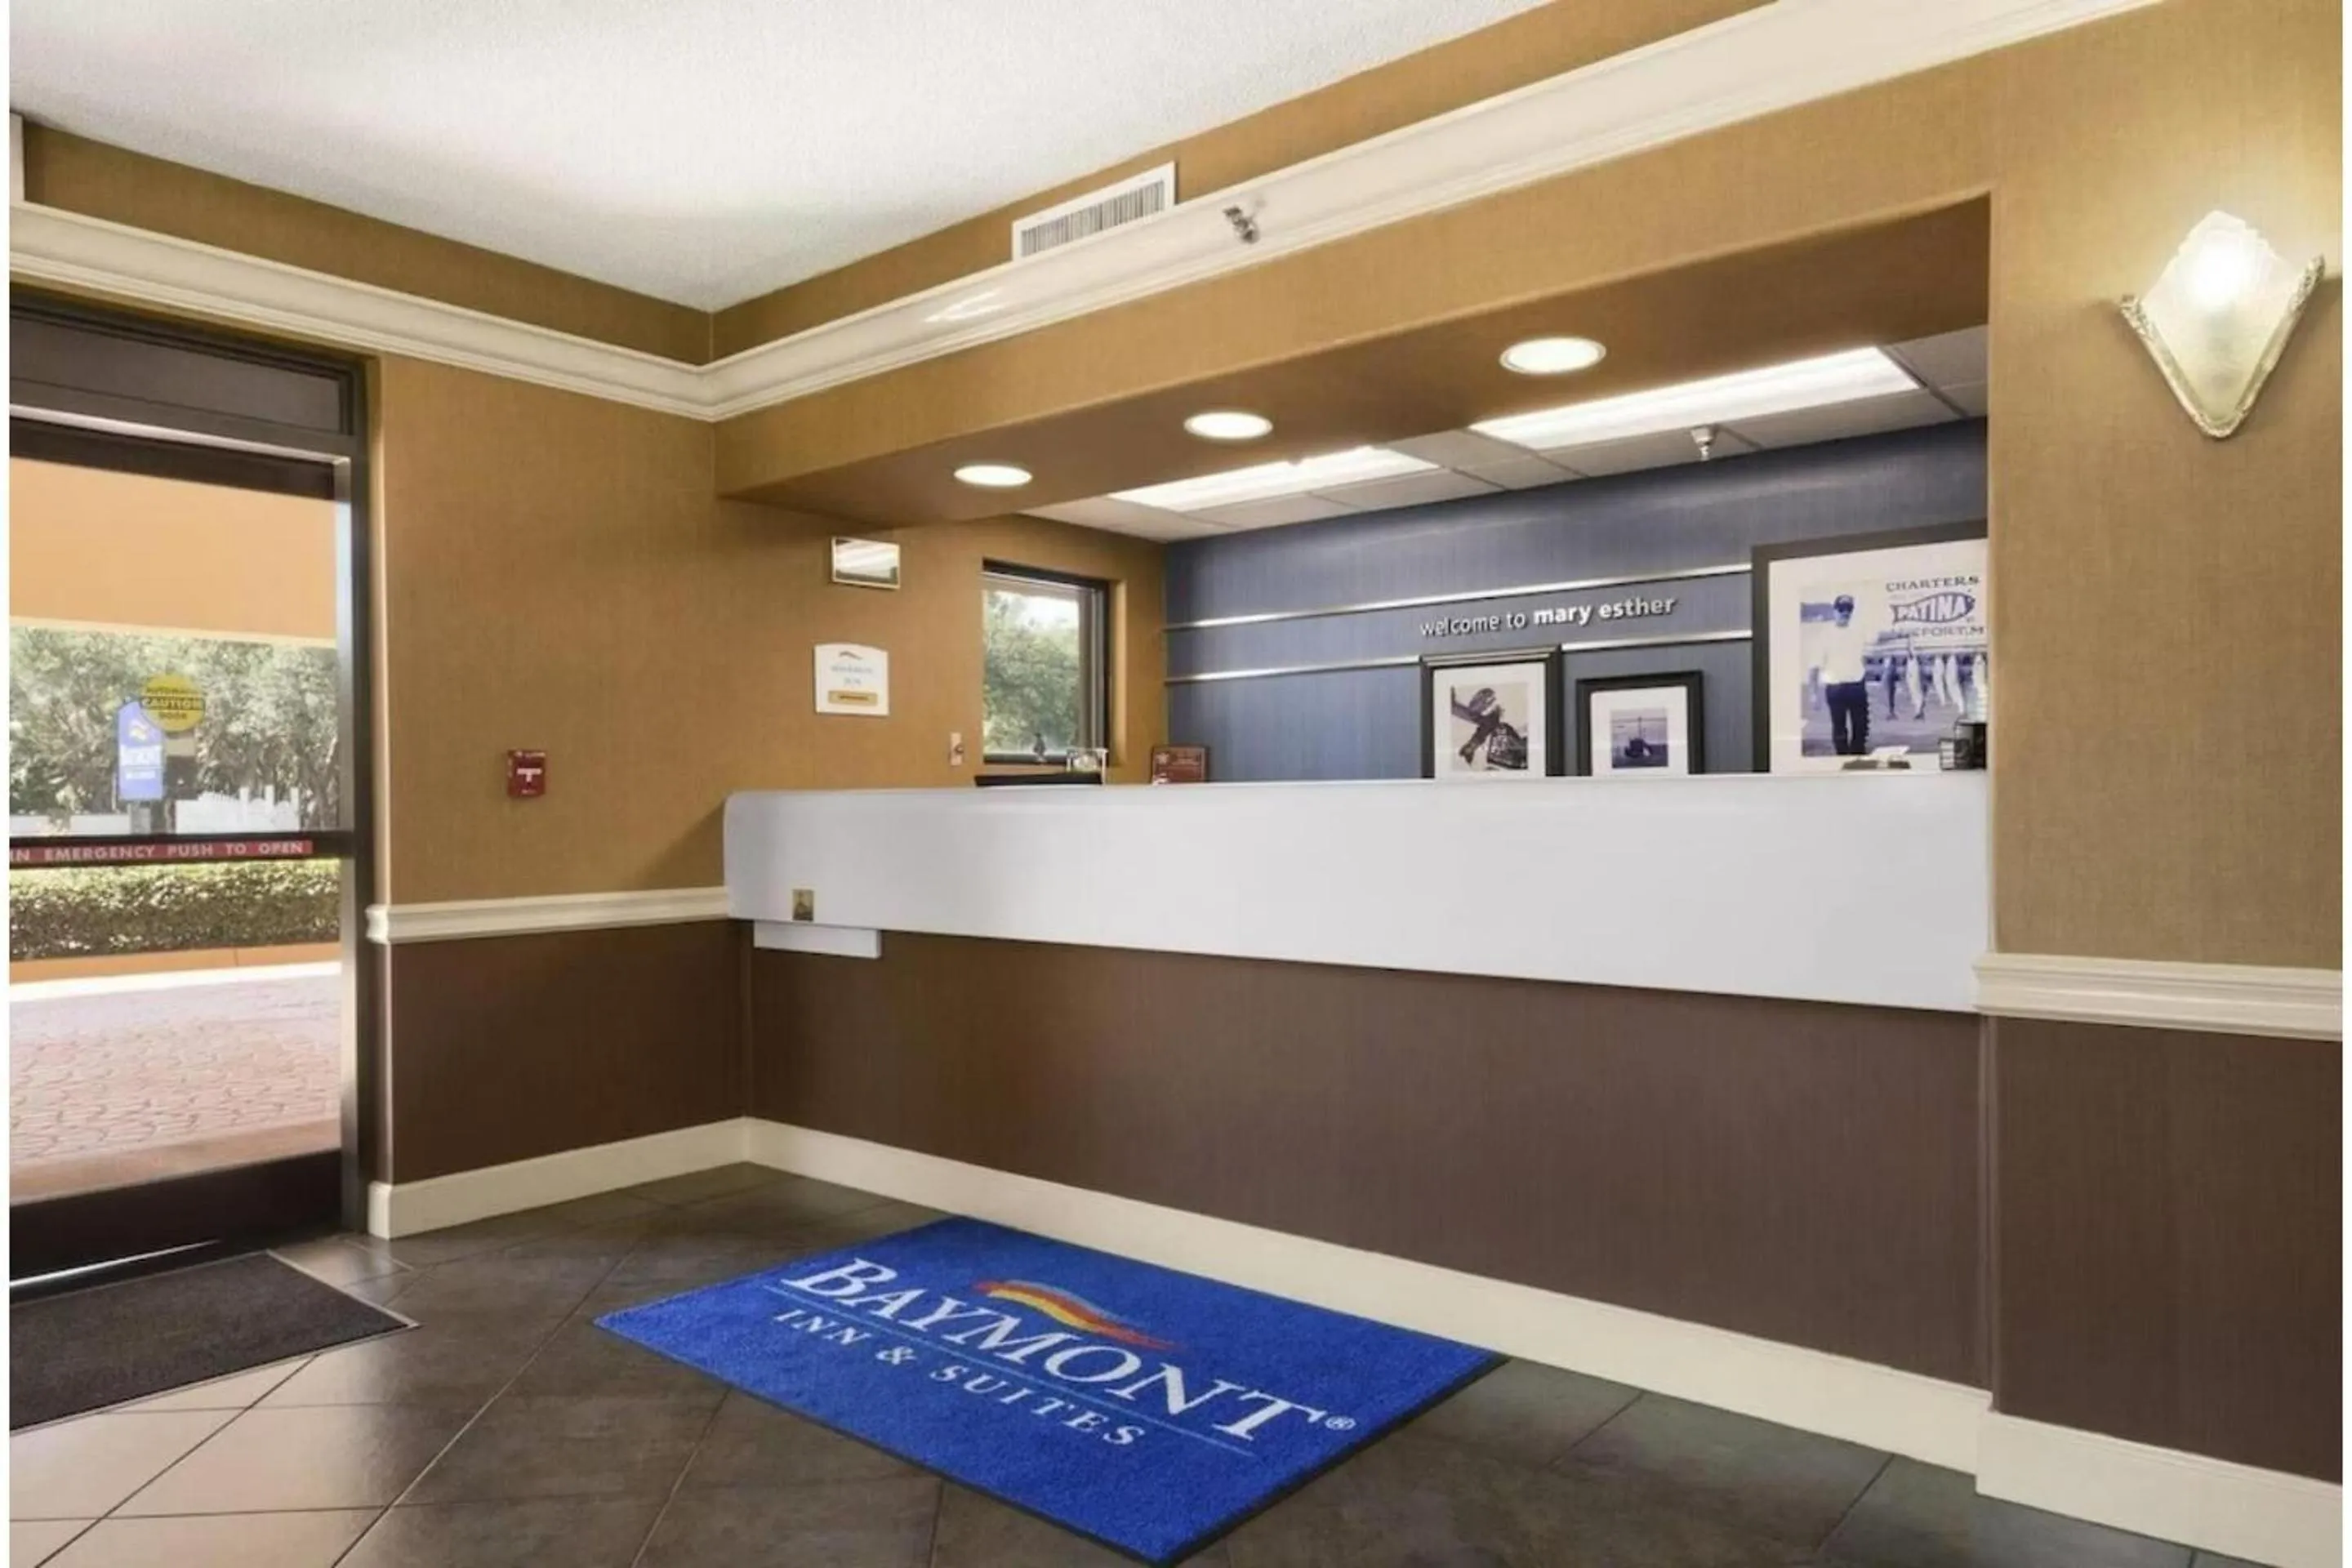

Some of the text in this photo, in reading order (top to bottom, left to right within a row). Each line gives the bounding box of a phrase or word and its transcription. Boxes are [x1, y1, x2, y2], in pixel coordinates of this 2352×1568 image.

[1886, 575, 1980, 593] CHARTERS
[1419, 596, 1677, 637] welcome to mary esther
[142, 697, 203, 710] CAUTION
[9, 840, 305, 862] IN EMERGENCY PUSH TO OPEN
[780, 1257, 1329, 1441] BAYMONT
[773, 1307, 1146, 1446] INN & SUITES
